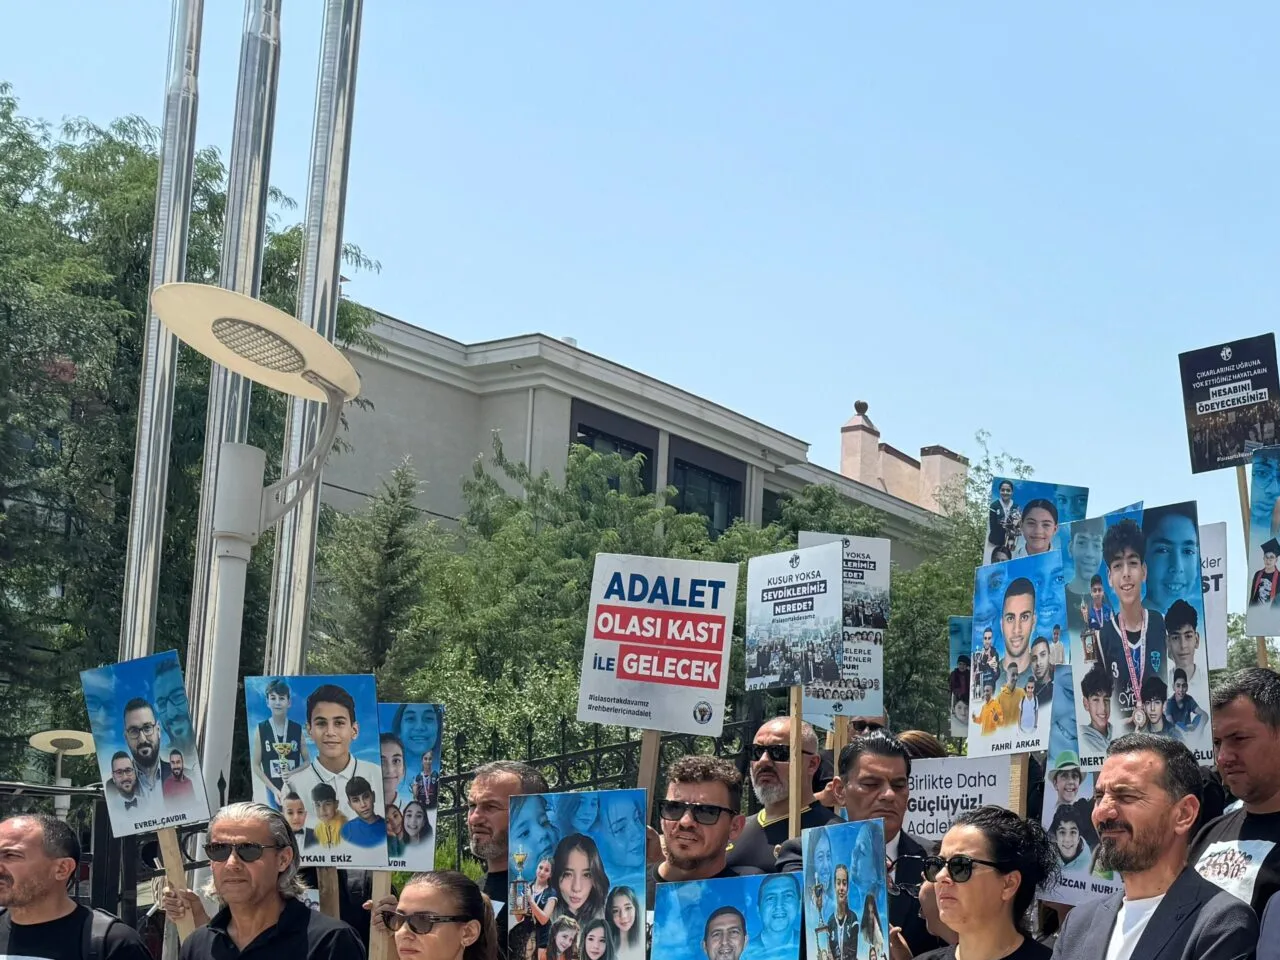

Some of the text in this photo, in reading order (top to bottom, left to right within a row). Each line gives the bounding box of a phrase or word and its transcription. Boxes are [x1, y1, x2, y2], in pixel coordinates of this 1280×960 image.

[1211, 383, 1250, 398] HESABINI
[767, 570, 821, 586] KUSUR YOKSA
[604, 572, 725, 609] ADALET
[763, 583, 825, 600] SEVDİKLERİMİZ
[775, 601, 812, 614] NEREDE?
[597, 612, 722, 643] OLASI KAST
[593, 653, 718, 682] İLE GELECEK
[991, 739, 1041, 752] FAHRİ ARKAR
[1080, 756, 1104, 766] MERT
[908, 772, 997, 791] Birlikte Daha
[907, 794, 983, 816] Güçlüyüz!
[161, 814, 187, 826] ÇAVDIR
[331, 853, 352, 863] EKİZ
